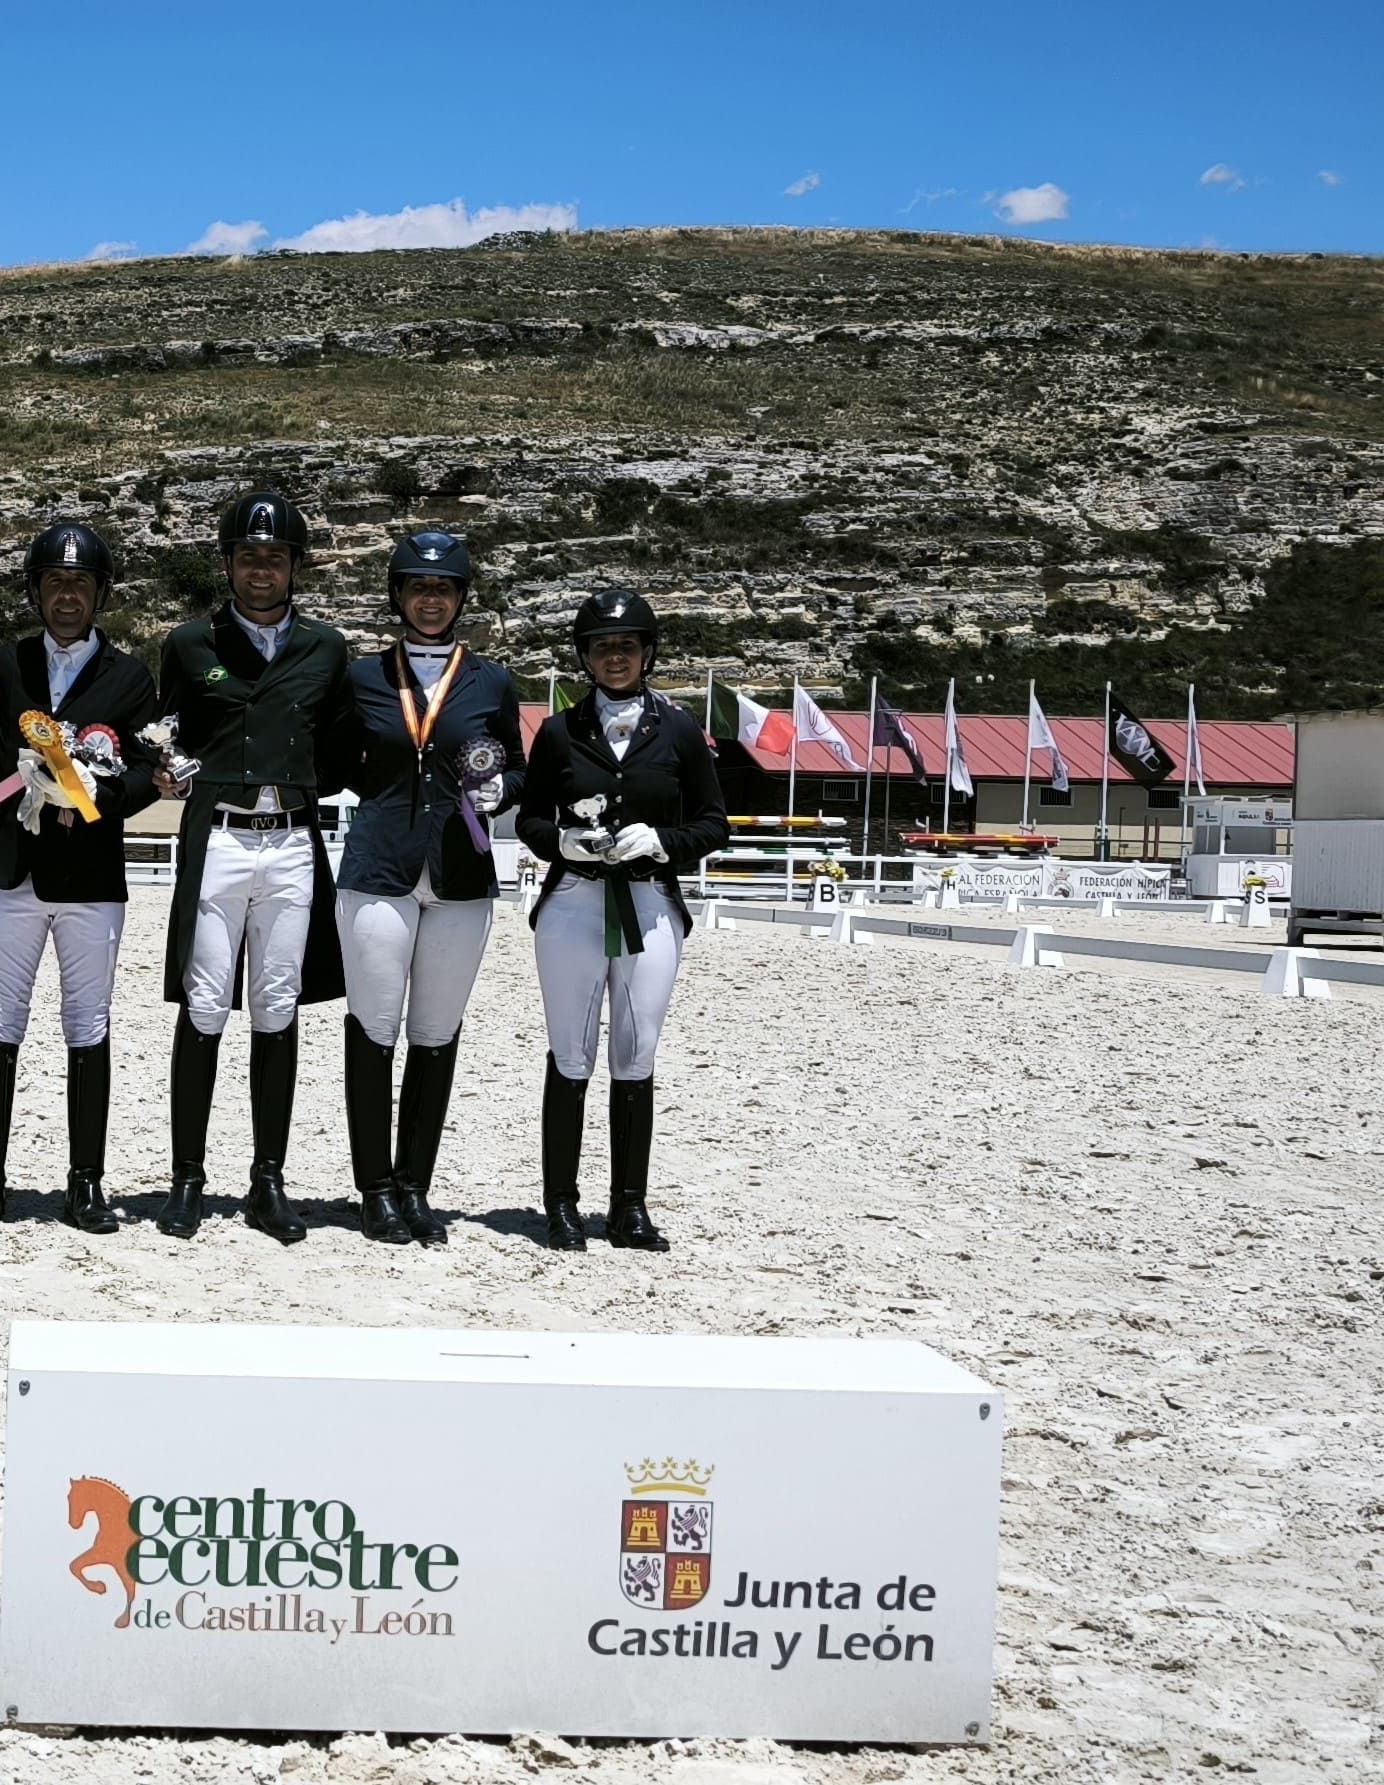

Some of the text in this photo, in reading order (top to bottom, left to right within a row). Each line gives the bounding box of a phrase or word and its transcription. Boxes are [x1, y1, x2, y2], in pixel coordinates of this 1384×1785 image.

[524, 872, 536, 886] R
[820, 883, 835, 902] B
[947, 879, 956, 891] H
[1254, 890, 1266, 905] S
[128, 1488, 356, 1542] centro
[126, 1531, 459, 1592] ecuestre
[723, 1572, 937, 1612] Junta de
[134, 1591, 456, 1645] de Castilla y León
[588, 1619, 935, 1671] Castilla y León
